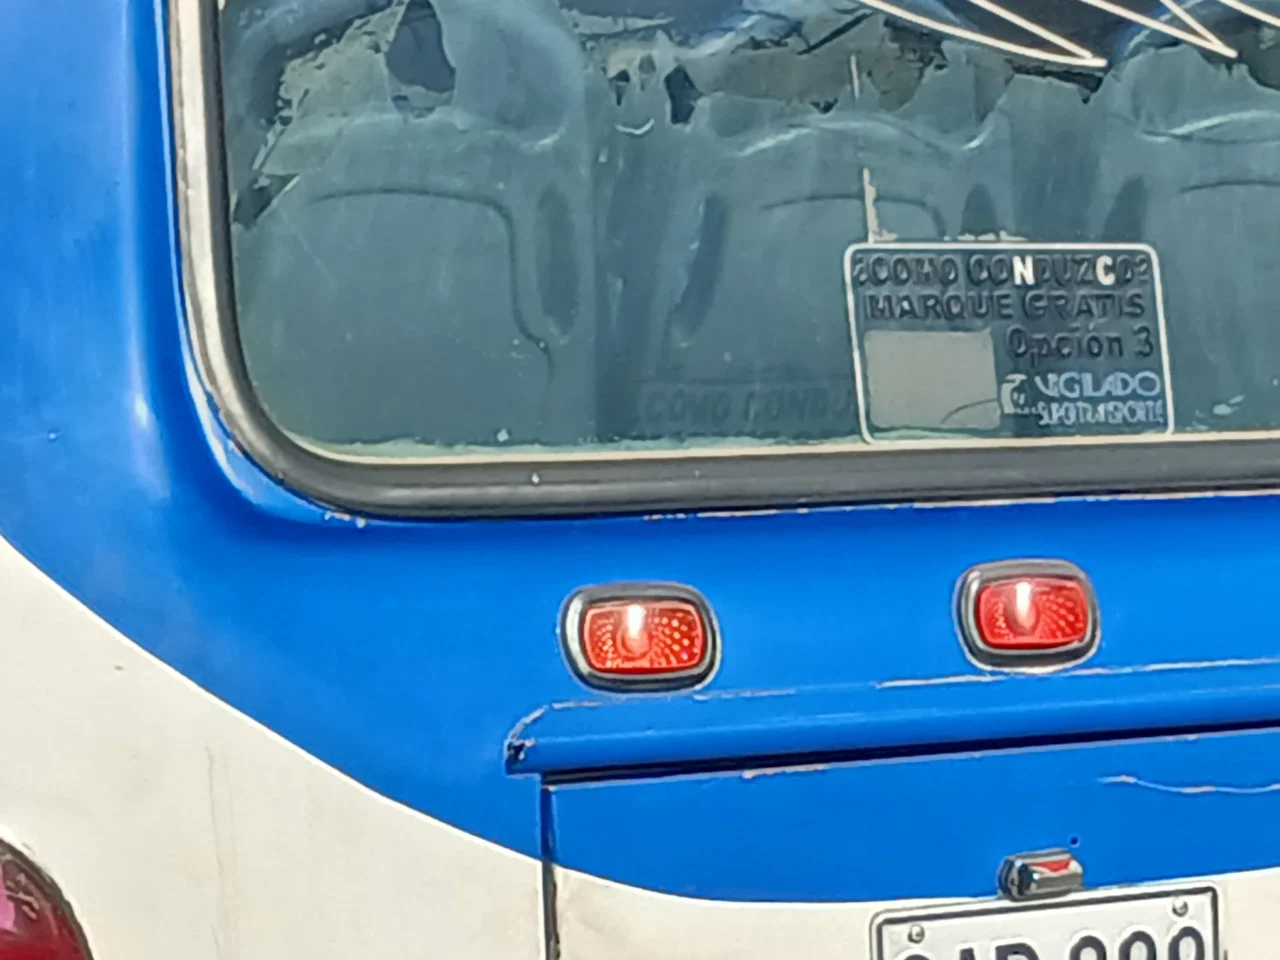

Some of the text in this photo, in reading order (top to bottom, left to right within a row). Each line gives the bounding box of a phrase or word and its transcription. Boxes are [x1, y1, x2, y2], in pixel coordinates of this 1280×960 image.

[867, 290, 1145, 320] MARQUE GRATIS
[1133, 322, 1155, 358] 3
